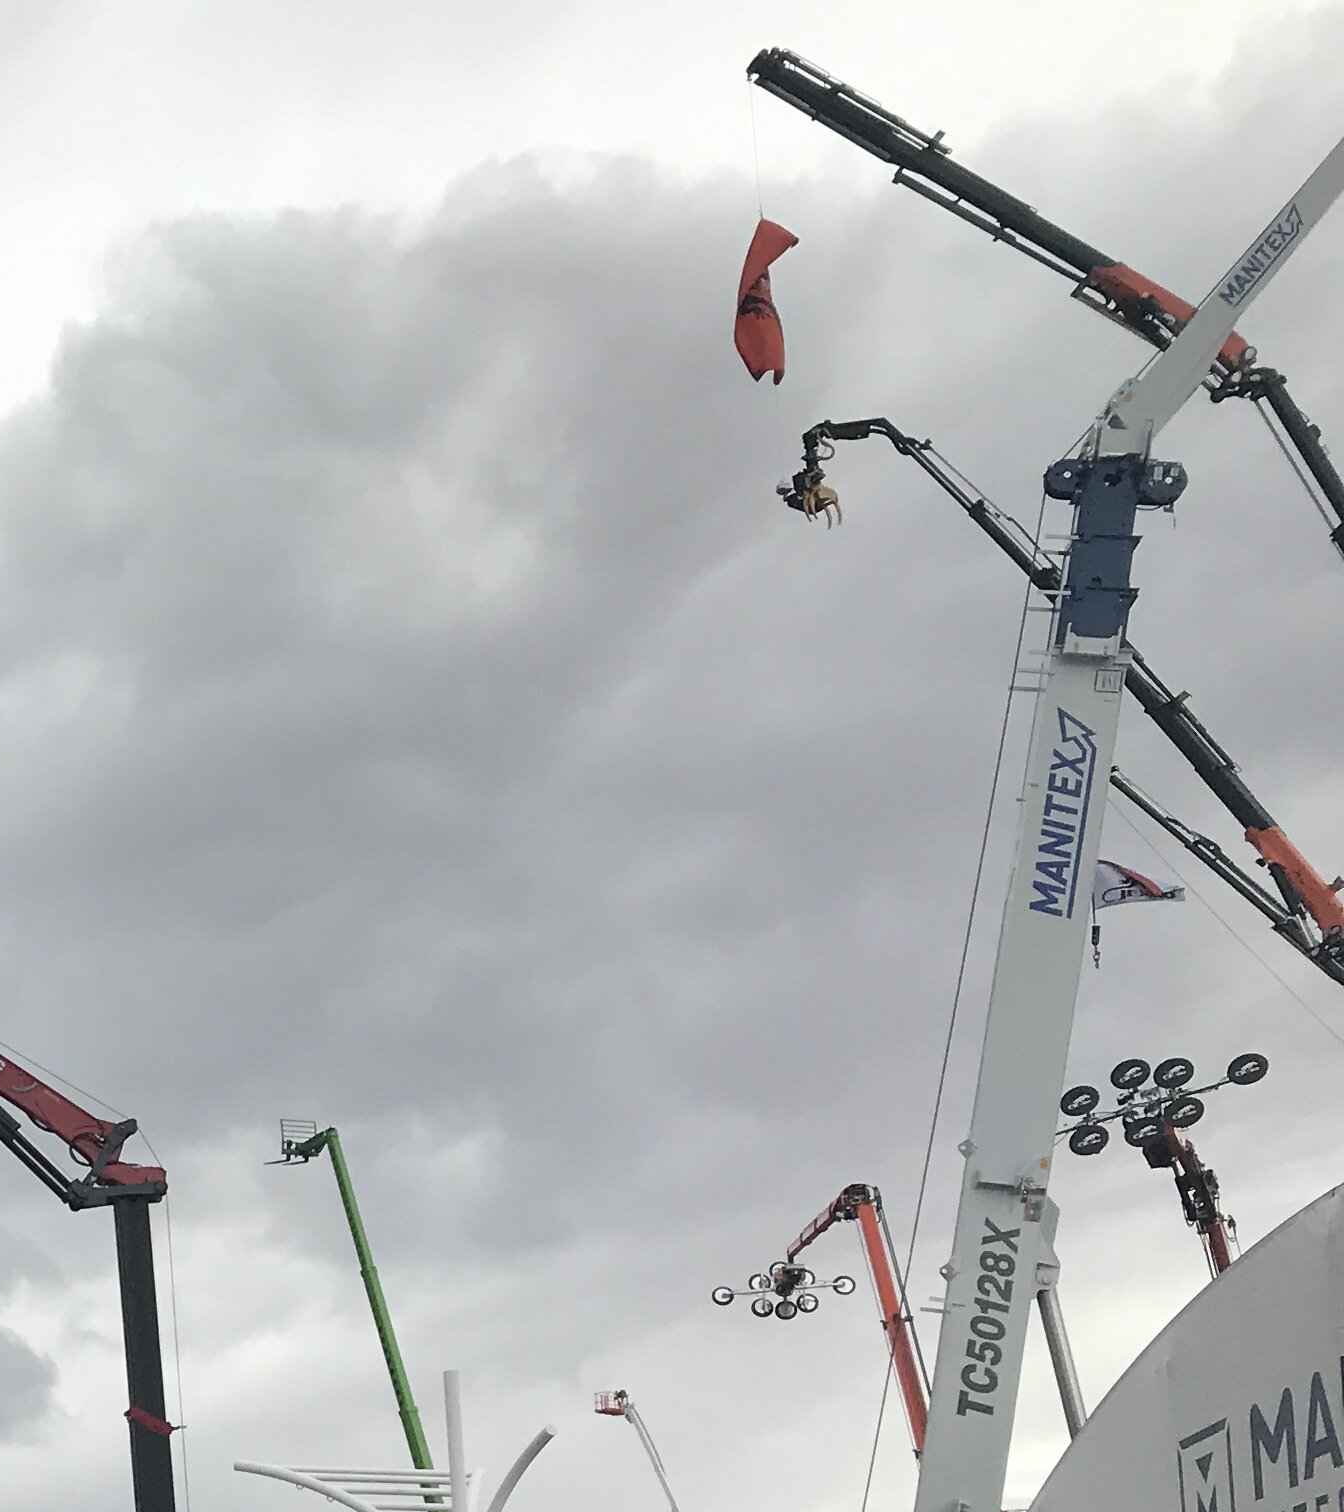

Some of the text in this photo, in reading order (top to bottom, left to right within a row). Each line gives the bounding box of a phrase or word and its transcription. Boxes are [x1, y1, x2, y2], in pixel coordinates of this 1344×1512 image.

[1220, 222, 1293, 306] MANITEX
[1029, 747, 1089, 918] MANITEX
[957, 1217, 1022, 1419] TC50128X
[1250, 1356, 1344, 1501] MA
